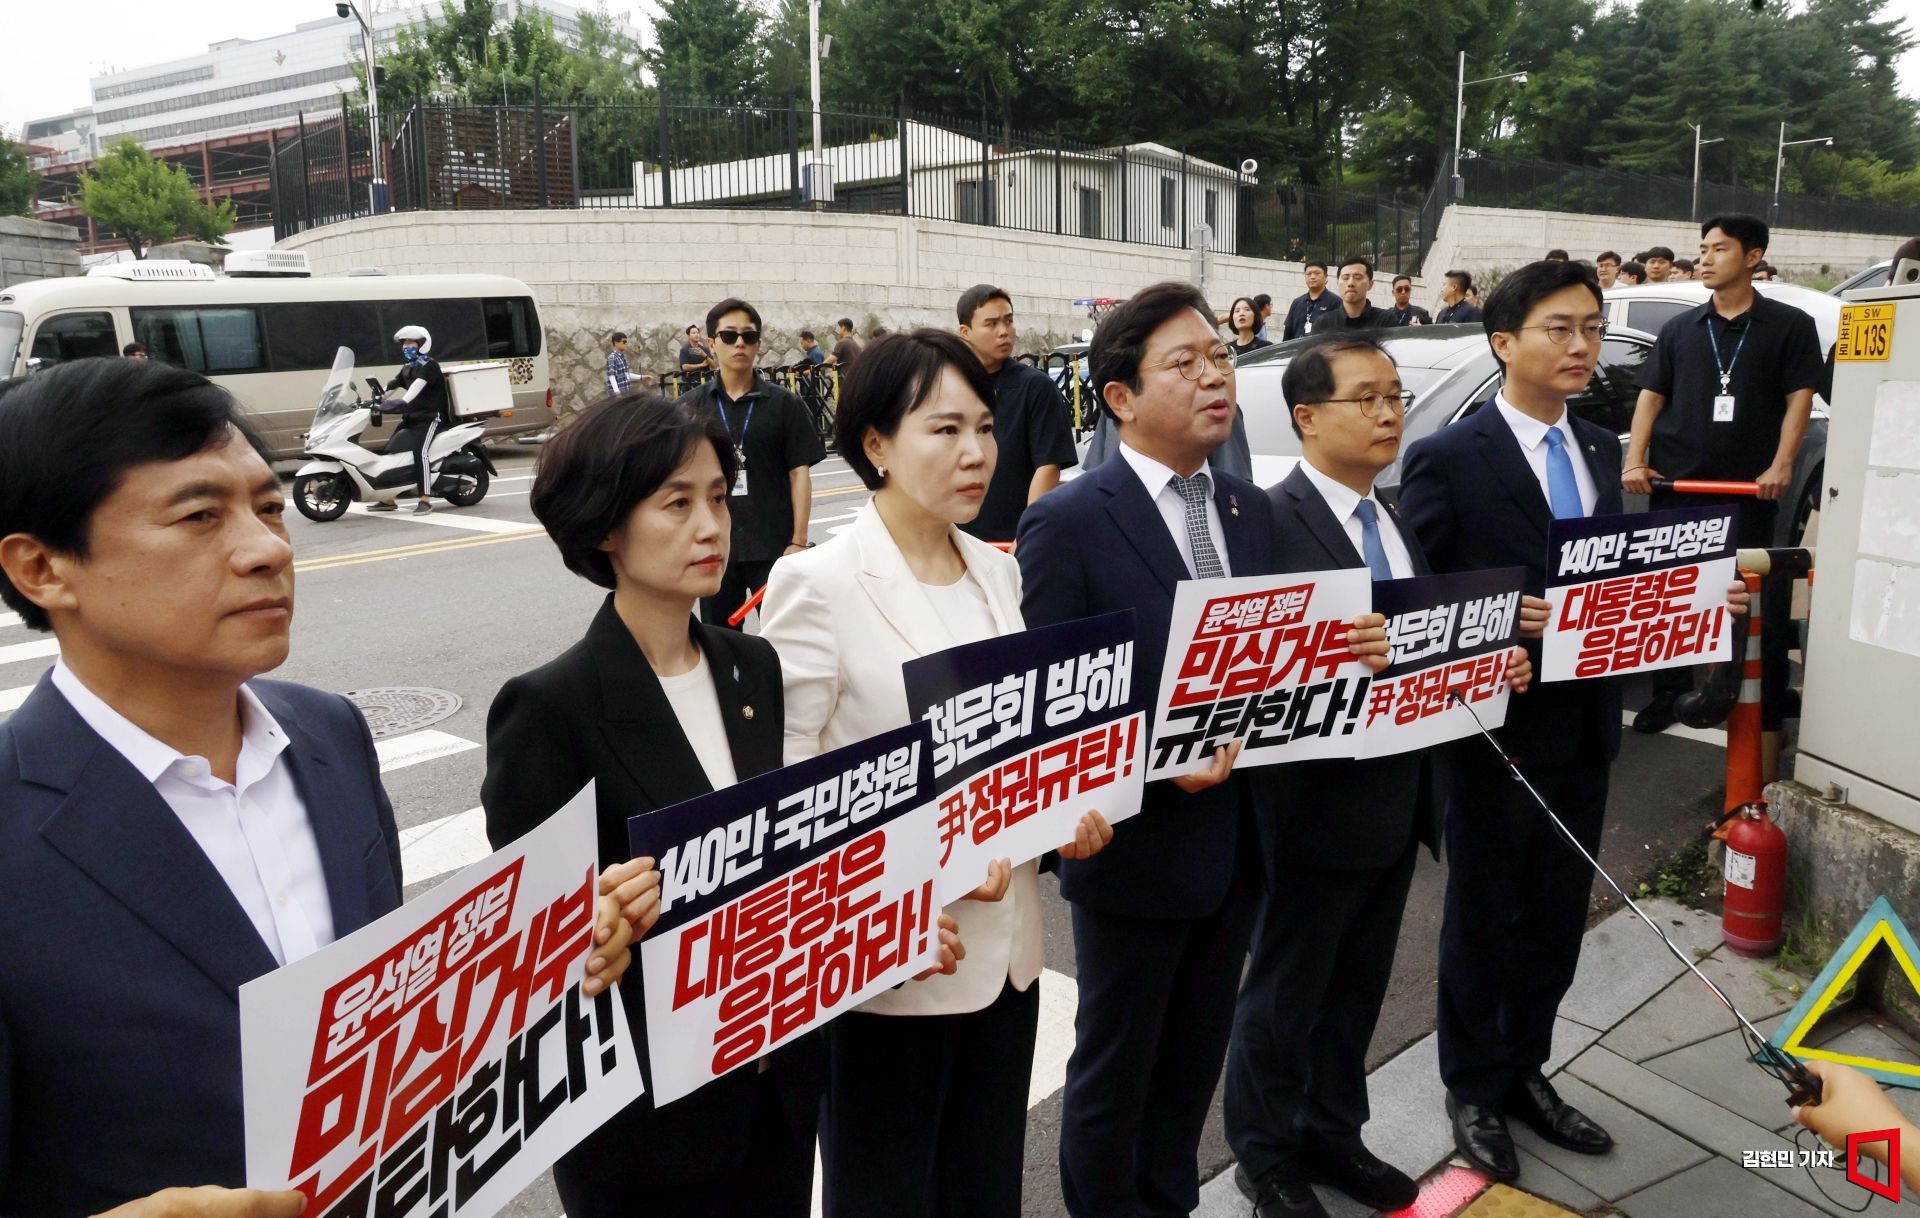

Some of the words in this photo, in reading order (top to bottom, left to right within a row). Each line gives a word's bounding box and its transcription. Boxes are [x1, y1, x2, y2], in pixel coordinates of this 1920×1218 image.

[1855, 323, 1886, 356] L13S
[1864, 308, 1881, 318] SW
[1558, 532, 1627, 576] 140만
[1628, 516, 1731, 564] 국민청원
[1201, 598, 1268, 634] 윤석열
[1266, 589, 1308, 624] 정부
[1457, 591, 1520, 649] 방해
[1557, 565, 1699, 632] 대통령은
[1575, 606, 1724, 678] 응답하라!
[1168, 619, 1361, 707] 민심거부
[922, 668, 1038, 779] 청문회
[1045, 640, 1134, 728] 방해
[1152, 676, 1371, 770] 규탄한다!
[659, 806, 769, 914] 140만
[774, 740, 921, 850] 국민청원
[327, 919, 447, 1050] 윤석열
[446, 873, 514, 962] 정부
[672, 829, 886, 1012] 대통령은
[711, 878, 933, 1076] 응답하라!
[288, 862, 595, 1218] 민심거부
